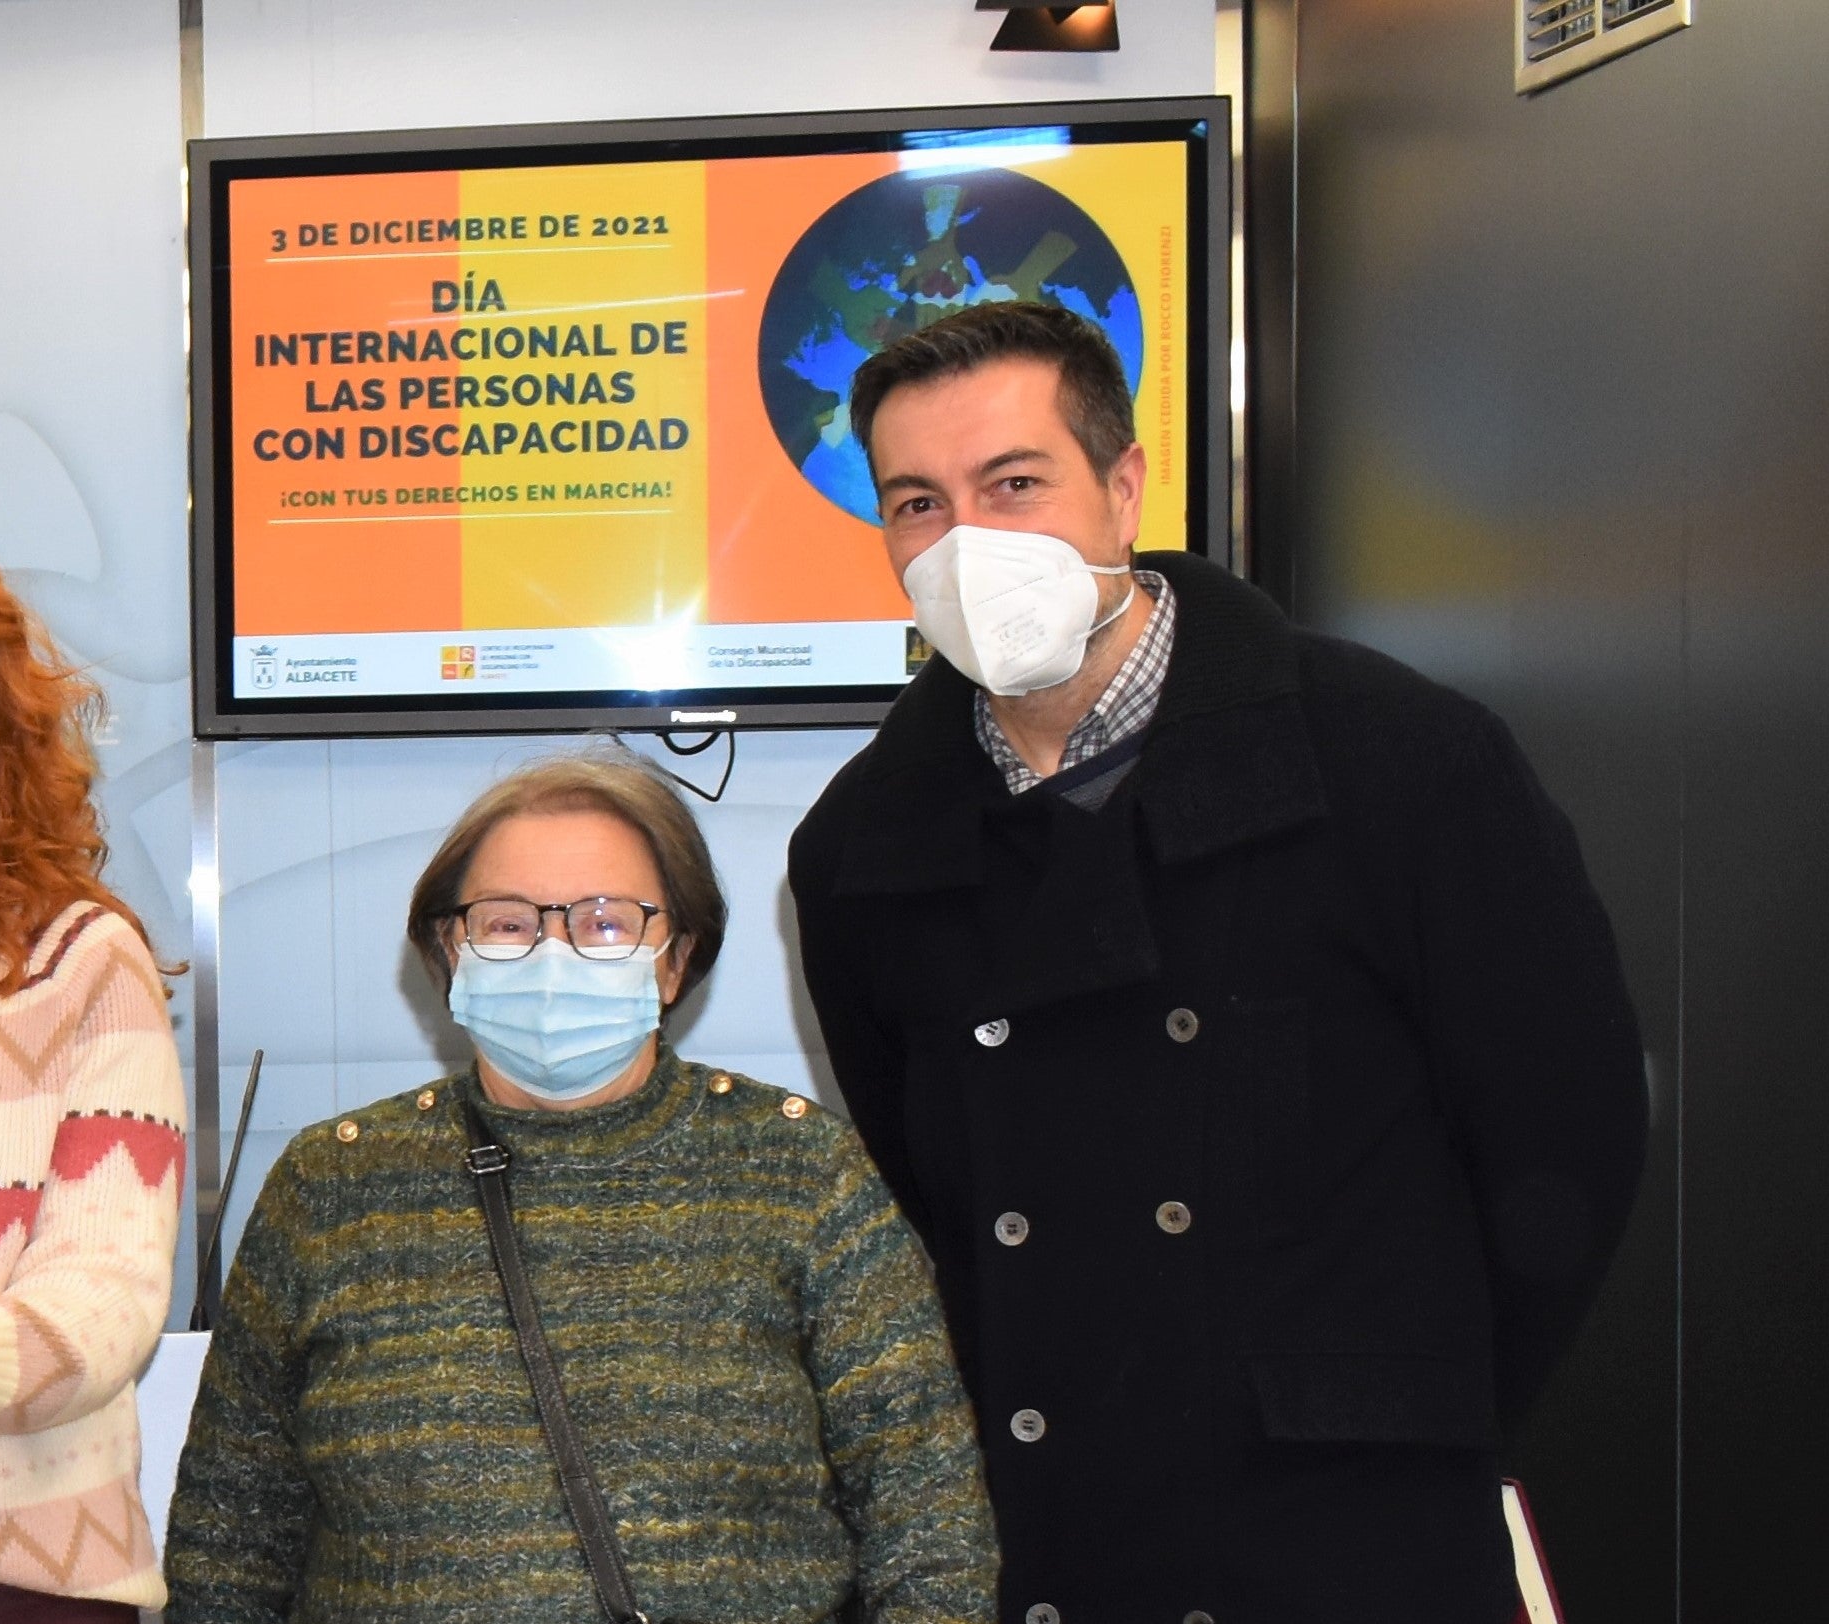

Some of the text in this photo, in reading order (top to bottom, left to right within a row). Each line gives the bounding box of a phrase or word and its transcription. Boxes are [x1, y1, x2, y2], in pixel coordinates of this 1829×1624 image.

[270, 214, 669, 252] 3 DE DICIEMBRE DE 2021
[431, 271, 506, 313] DÍA
[254, 321, 688, 367] INTERNACIONAL DE
[1160, 226, 1171, 485] IMAGEN CEDIDA POR ROCCO FIORENZI
[305, 371, 636, 413] LAS PERSONAS
[253, 417, 690, 461] CON DISCAPACIDAD
[280, 481, 672, 508] ¡CON TUS DERECHOS EN MARCHA!
[285, 656, 357, 668] Ayuntamiento
[737, 656, 812, 668] Discapacidad
[757, 644, 812, 655] Municipal
[285, 670, 357, 683] ALBACETE
